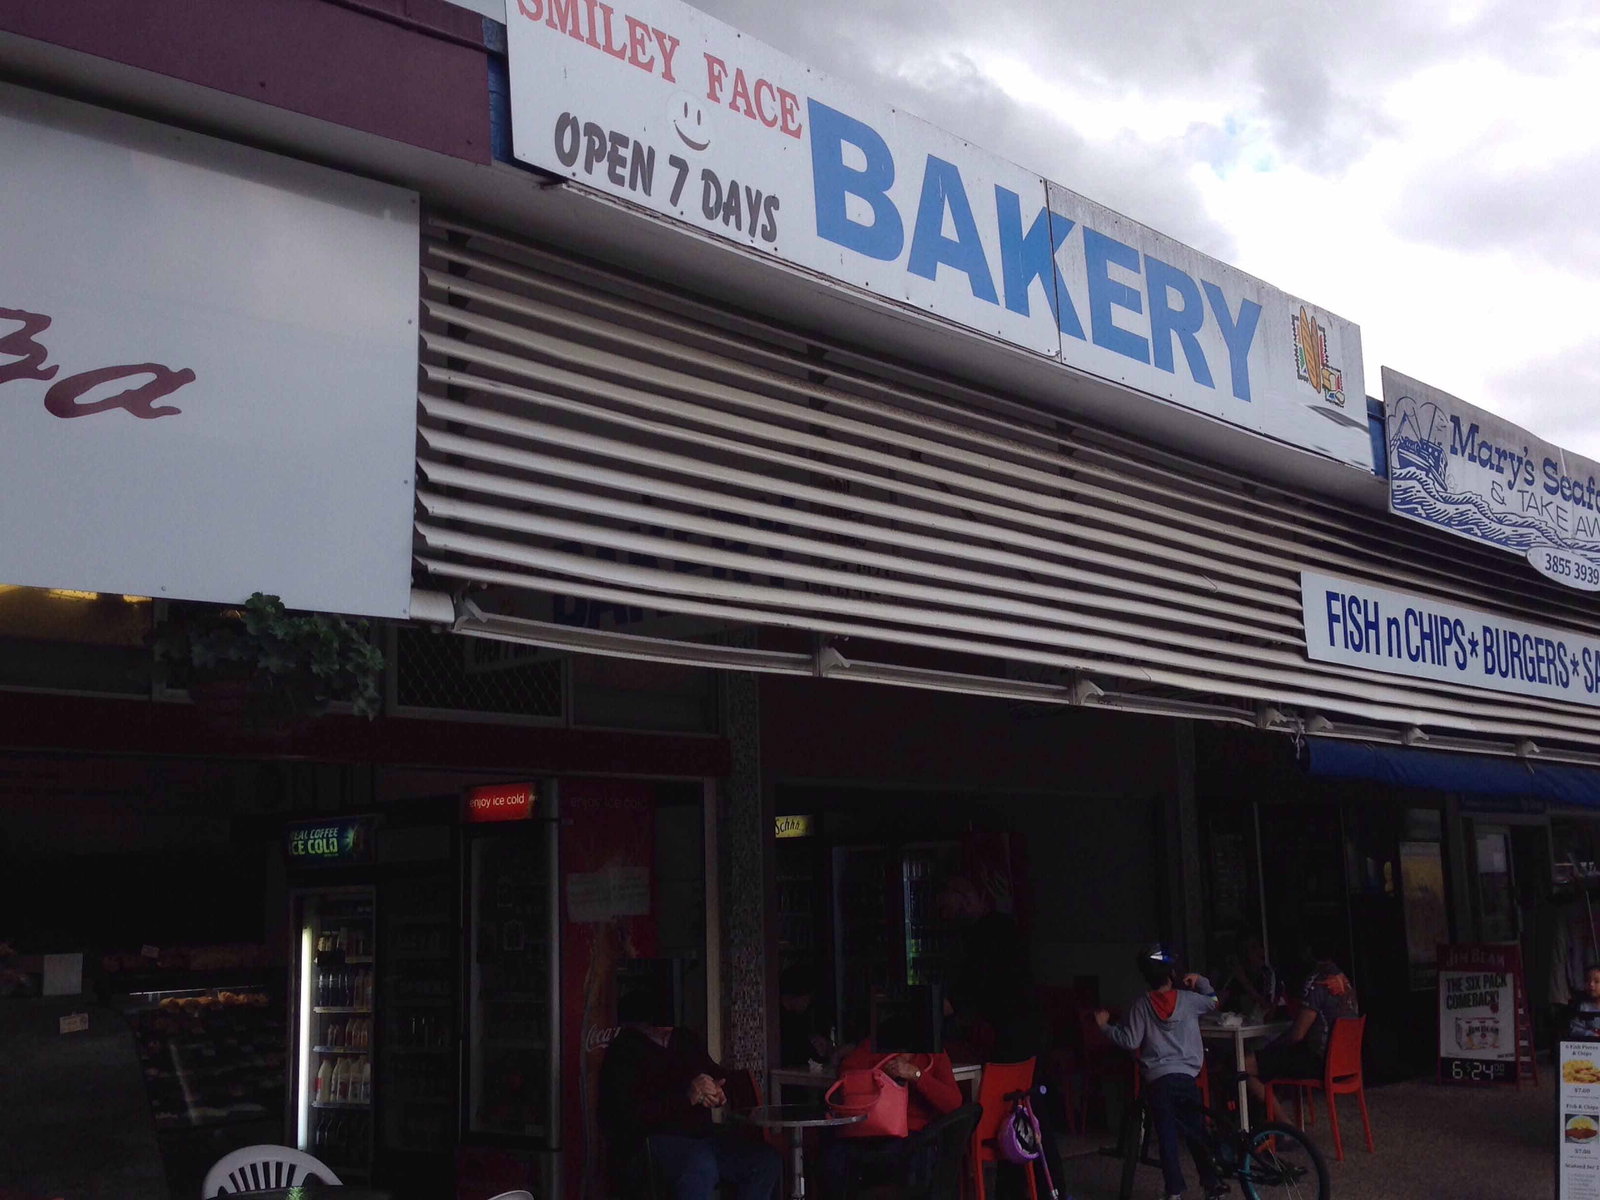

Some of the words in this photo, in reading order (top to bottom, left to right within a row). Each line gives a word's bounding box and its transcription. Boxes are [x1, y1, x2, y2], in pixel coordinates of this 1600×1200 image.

[518, 0, 680, 83] SMILEY
[703, 51, 803, 140] FACE
[554, 111, 656, 197] OPEN
[669, 154, 690, 208] 7
[701, 168, 780, 243] DAYS
[807, 97, 1262, 403] BAKERY
[1450, 414, 1535, 490] Mary's
[1517, 489, 1569, 532] TAKE
[1545, 553, 1571, 576] 3855
[1574, 562, 1600, 585] 3939
[1325, 590, 1380, 656] FISH
[1404, 607, 1468, 670] CHIPS
[1482, 625, 1570, 689] BURGERS
[492, 796, 505, 806] ice
[506, 793, 525, 805] cold
[307, 837, 339, 855] COLD
[310, 827, 339, 839] COFFEE
[1446, 978, 1464, 993] THE
[1465, 975, 1481, 991] SIX
[1483, 972, 1507, 989] PACK
[1451, 1060, 1464, 1080] 6
